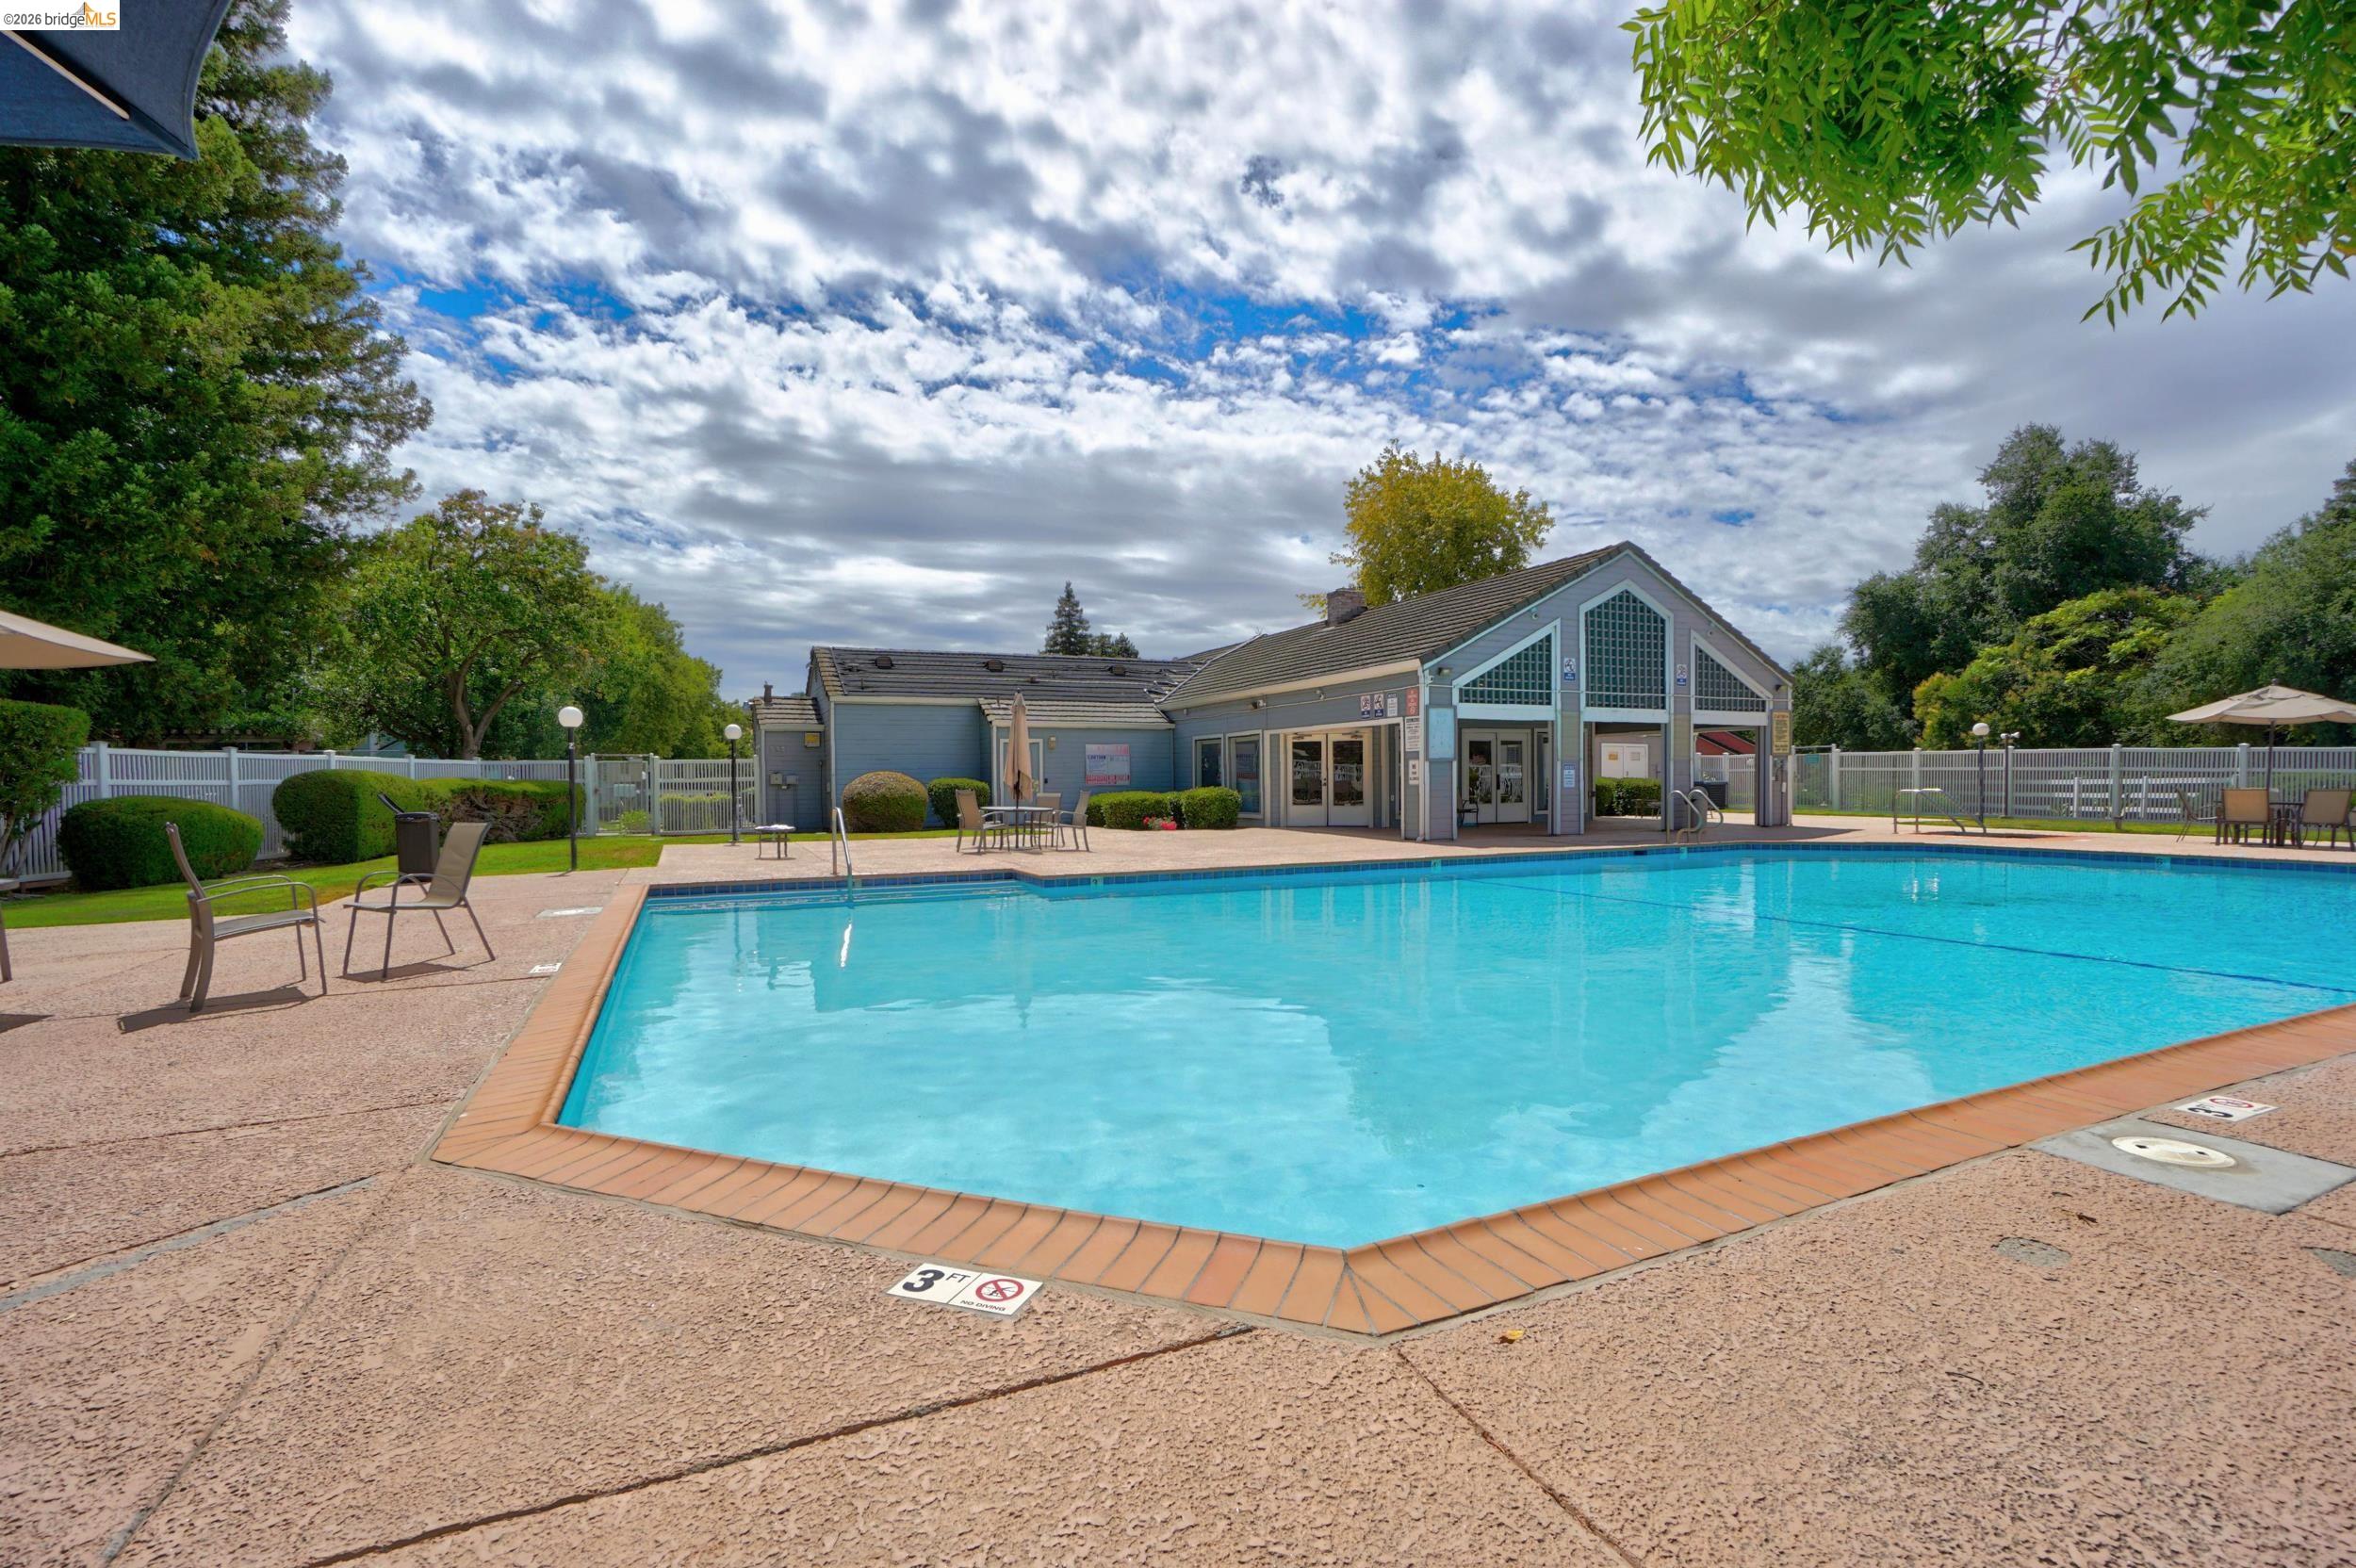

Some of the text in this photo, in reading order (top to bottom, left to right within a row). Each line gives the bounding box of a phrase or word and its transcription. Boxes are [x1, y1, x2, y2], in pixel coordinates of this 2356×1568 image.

[902, 1269, 971, 1292] 3 FT
[975, 1302, 1006, 1312] DIVING
